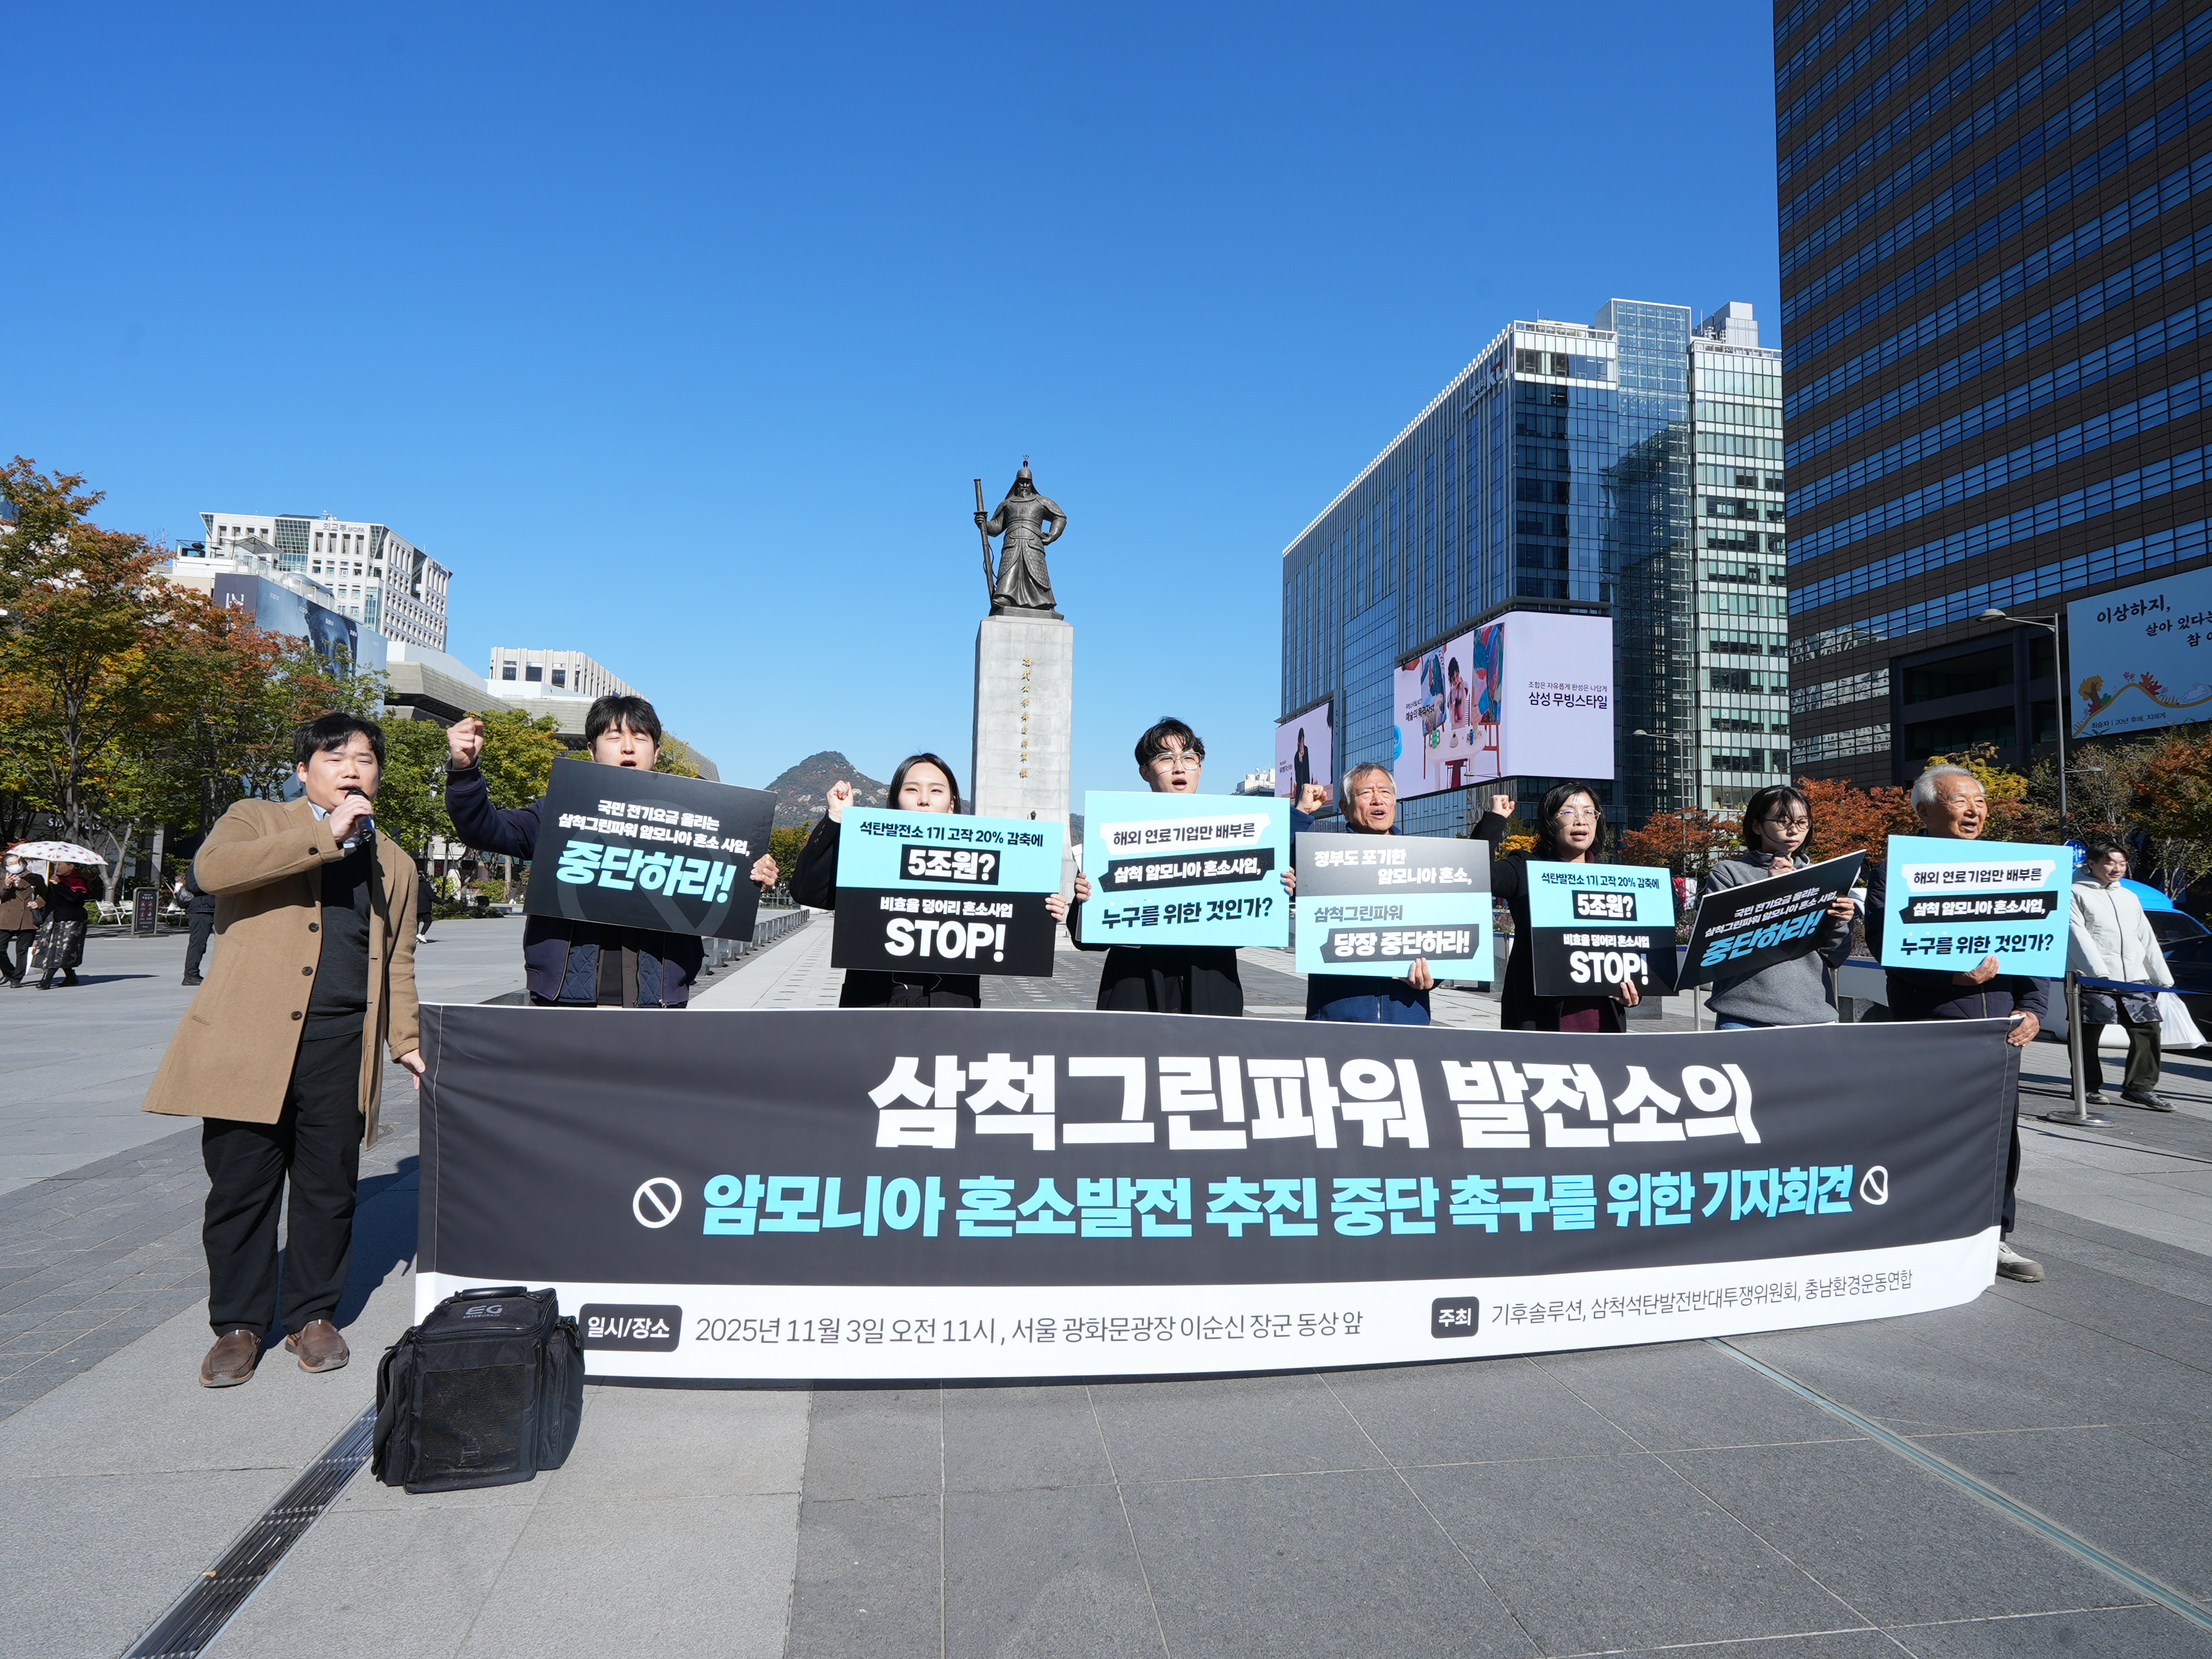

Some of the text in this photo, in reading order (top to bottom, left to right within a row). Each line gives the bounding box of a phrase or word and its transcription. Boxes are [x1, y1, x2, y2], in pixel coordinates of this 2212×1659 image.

[1487, 356, 1503, 391] kt
[323, 523, 346, 532] 외교부
[2097, 594, 2171, 624] 이상하지,
[2145, 619, 2173, 637] 살아
[2187, 632, 2201, 647] 참
[1528, 681, 1546, 689] 조합은
[1547, 682, 1571, 691] 자유롭게
[1571, 684, 1589, 692] 완성은
[1528, 692, 1607, 709] 삼성 무빙스타일
[2146, 712, 2166, 721] 지에게
[598, 799, 720, 832] 국민 전기요금 올리는
[558, 813, 750, 856] 삼척그린파워 암모니아 혼소 사업,
[859, 821, 1044, 847] 석탄발전소 1기 고작 20% 감축에
[1113, 822, 1255, 846] 해외 연료기업만 배부른
[907, 848, 995, 881] 5조원?
[1114, 858, 1261, 883] 삼척 암모니아 혼소사업,
[1314, 848, 1407, 868] 정부도 포기한
[556, 839, 738, 904] 중단하라!
[1378, 866, 1472, 886] 암모니아 혼소,
[1541, 872, 1660, 889] 석탄발전소 1기 고작 20% 감축에
[1913, 868, 2042, 885] 해외 연료기업만 배부른
[880, 896, 1013, 919] 비효율 덩어리 혼소사업
[1102, 897, 1273, 929] 누구를 위한 것인가?
[1314, 904, 1404, 923] 삼척그린파워
[1577, 893, 1634, 918] 5조원?
[1705, 890, 1838, 938] 삼척그린파워 암모니아 혼소 사업,
[1734, 887, 1820, 918] 국민 전기요금 올리는
[1913, 899, 2046, 917] 삼척 암모니아 혼소사업,
[884, 918, 1006, 962] STOP!
[1334, 930, 1470, 957] 당장 중단하라!
[1563, 933, 1650, 948] 비효율 덩어리 혼소사업
[1700, 909, 1827, 967] 중단하라!
[1900, 933, 2054, 955] 누구를 위한 것인가?
[1570, 951, 1649, 985] STOP!
[868, 1053, 1762, 1151] 삼척그린파워 발전소의
[703, 1165, 1853, 1237] 암모니아 혼소발전 추진 중단 촉구를 위한 기자회견
[465, 1304, 503, 1315] EG
[1491, 1269, 1913, 1326] 기후솔루션, 삼척석탄발전반대투쟁위원회, 충남환경운동연합
[587, 1316, 670, 1339] 일시/장소
[695, 1311, 1363, 1346] 2025년 11월 3일 오전 11시, 서울 광화문광장 이순신 장군 동상 앞
[1438, 1308, 1472, 1327] 주최
